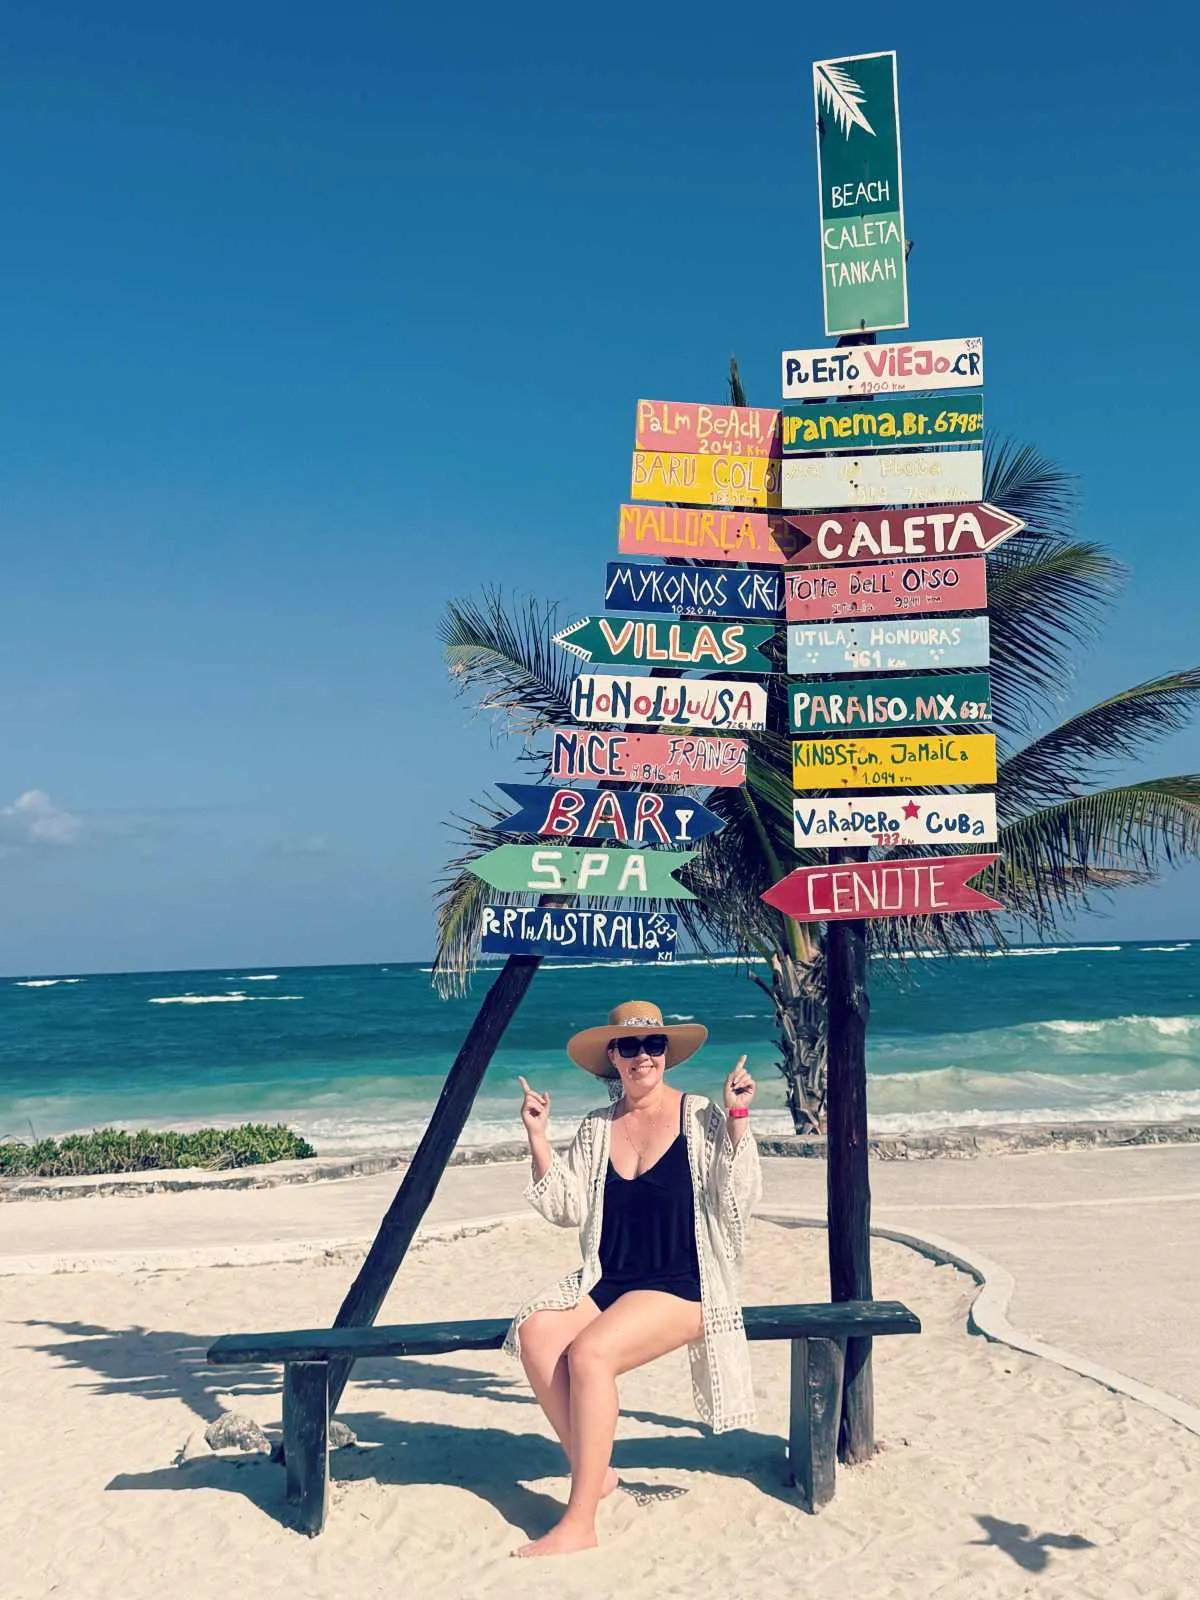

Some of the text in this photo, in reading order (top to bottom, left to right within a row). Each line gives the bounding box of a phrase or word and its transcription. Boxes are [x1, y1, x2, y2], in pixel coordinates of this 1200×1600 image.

[832, 180, 890, 209] BEACH
[824, 220, 900, 250] CALETA
[826, 258, 896, 288] TANKAH
[699, 439, 742, 456] 2043
[817, 512, 986, 559] CALETA
[606, 568, 727, 607] MYKONOS
[599, 618, 747, 665] VILLAS
[667, 737, 748, 776] FRANCIA
[538, 789, 672, 844] BAR
[527, 851, 648, 892] SPA
[807, 865, 949, 915] CENOTE
